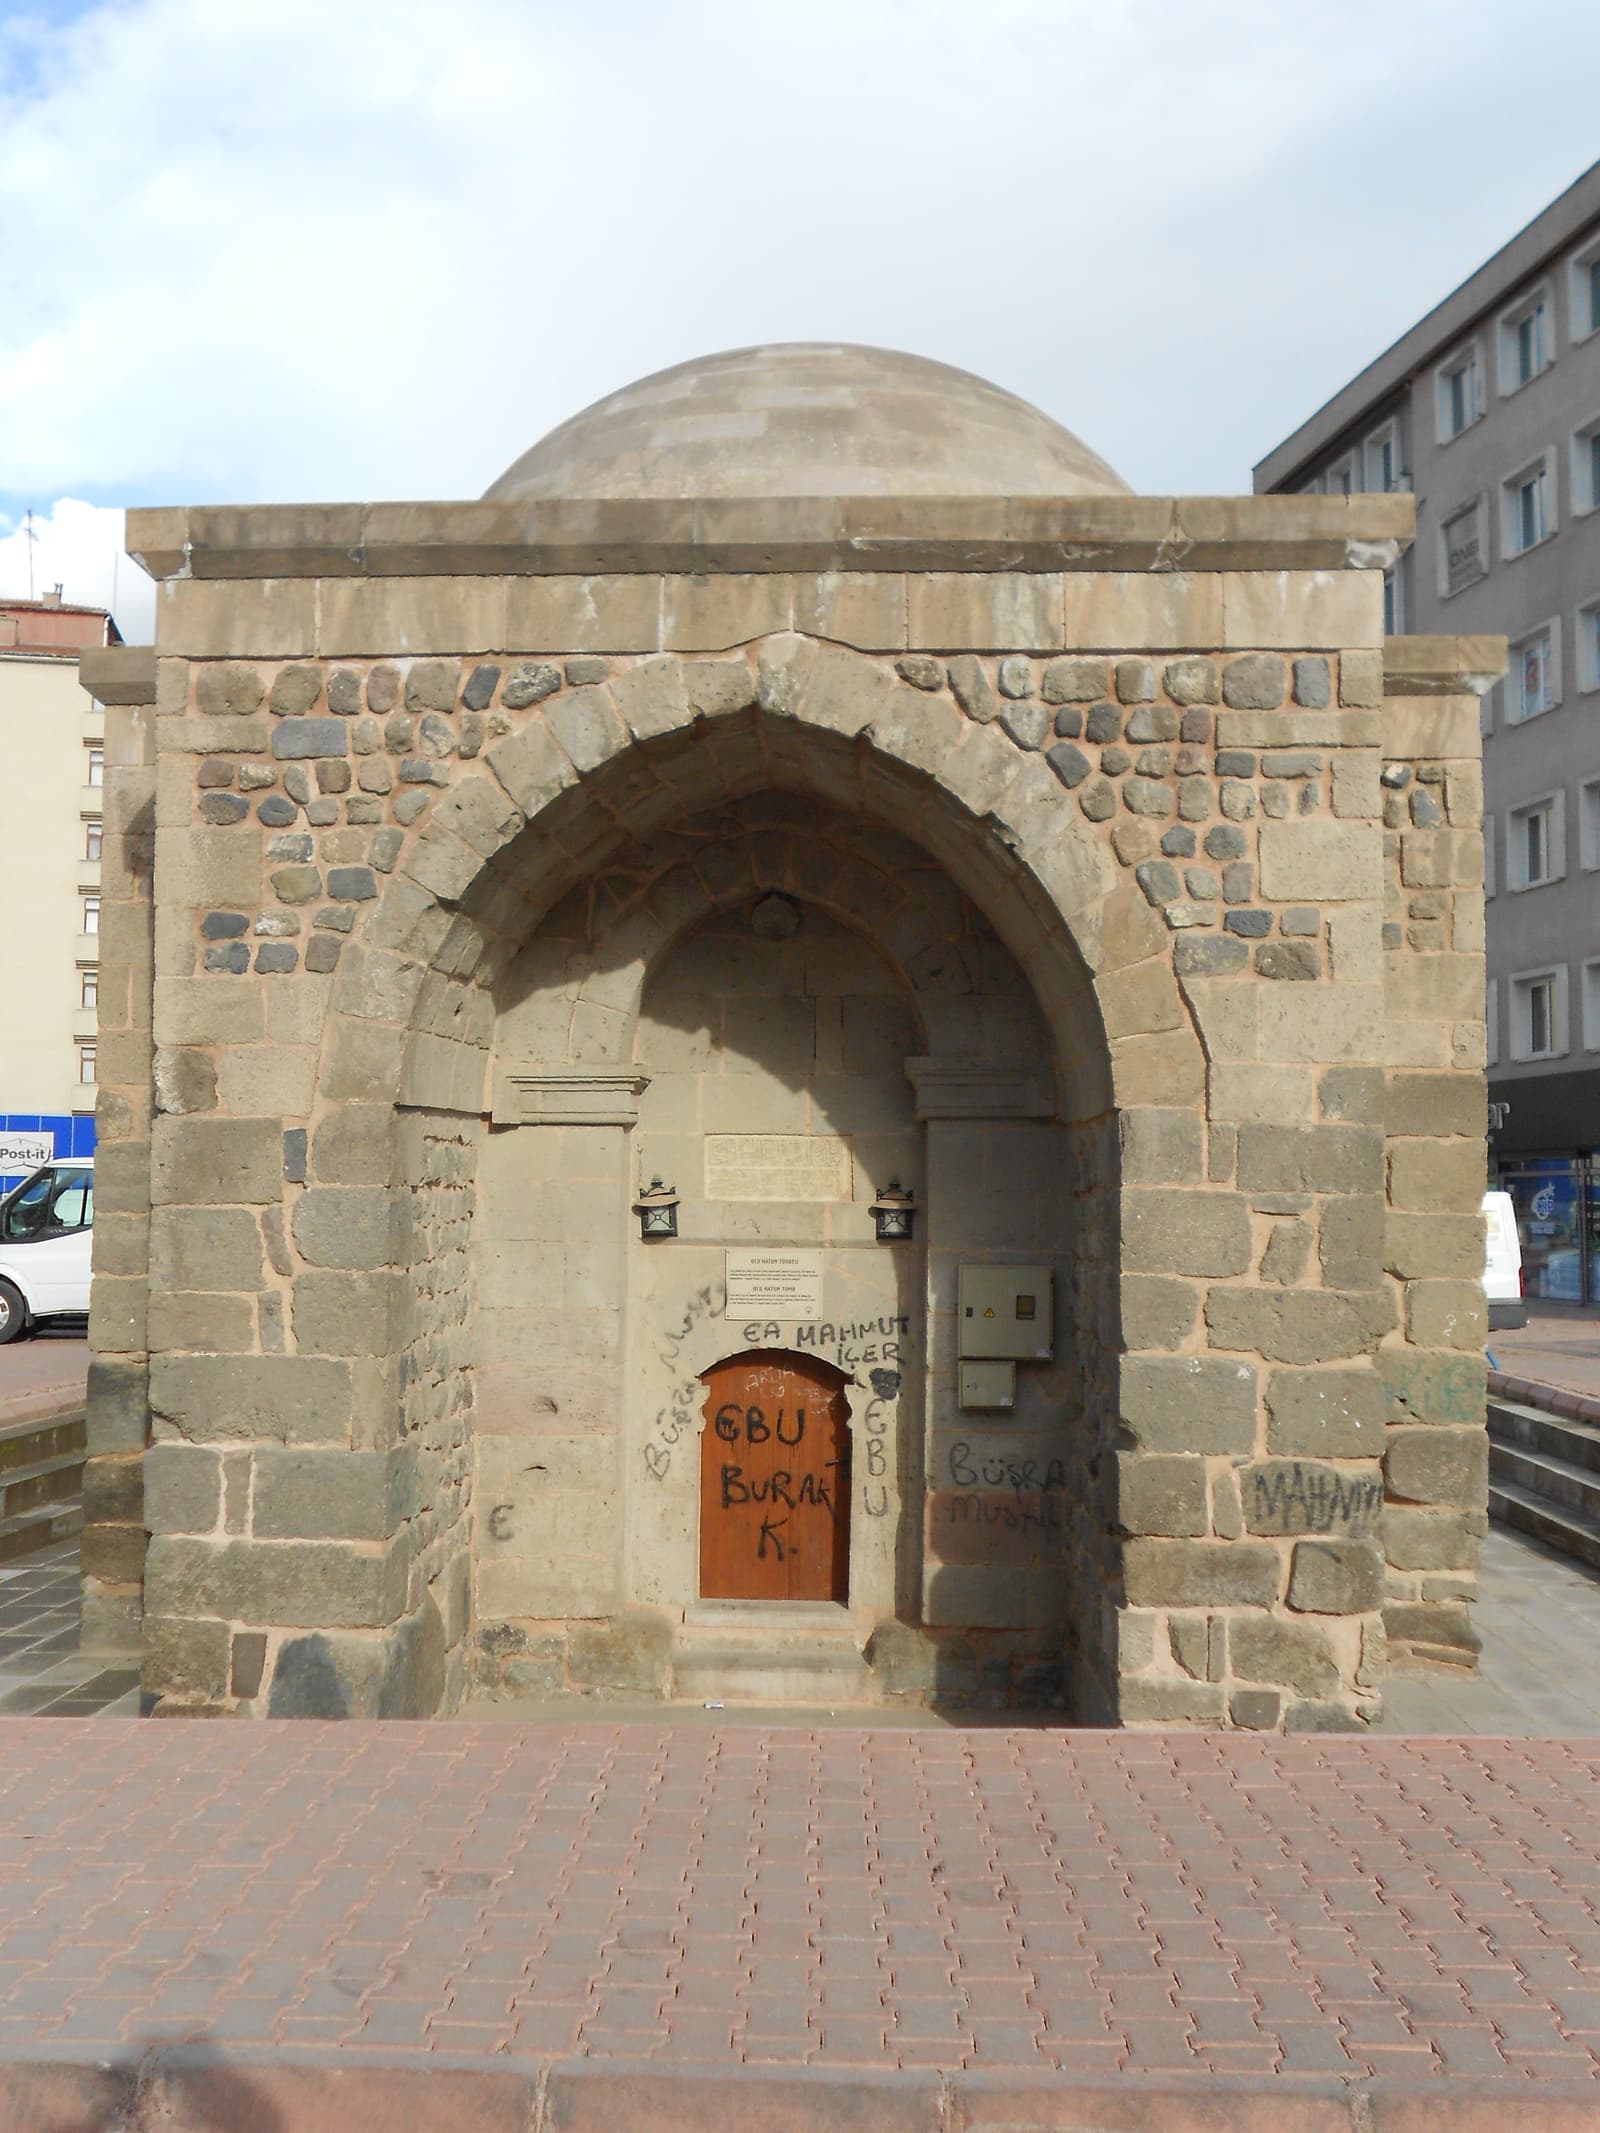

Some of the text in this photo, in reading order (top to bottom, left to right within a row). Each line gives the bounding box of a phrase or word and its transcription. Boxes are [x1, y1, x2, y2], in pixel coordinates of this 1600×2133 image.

[0, 1148, 46, 1160] Post-it
[796, 1315, 910, 1348] MAHMUT
[721, 1464, 836, 1514] BURAK
